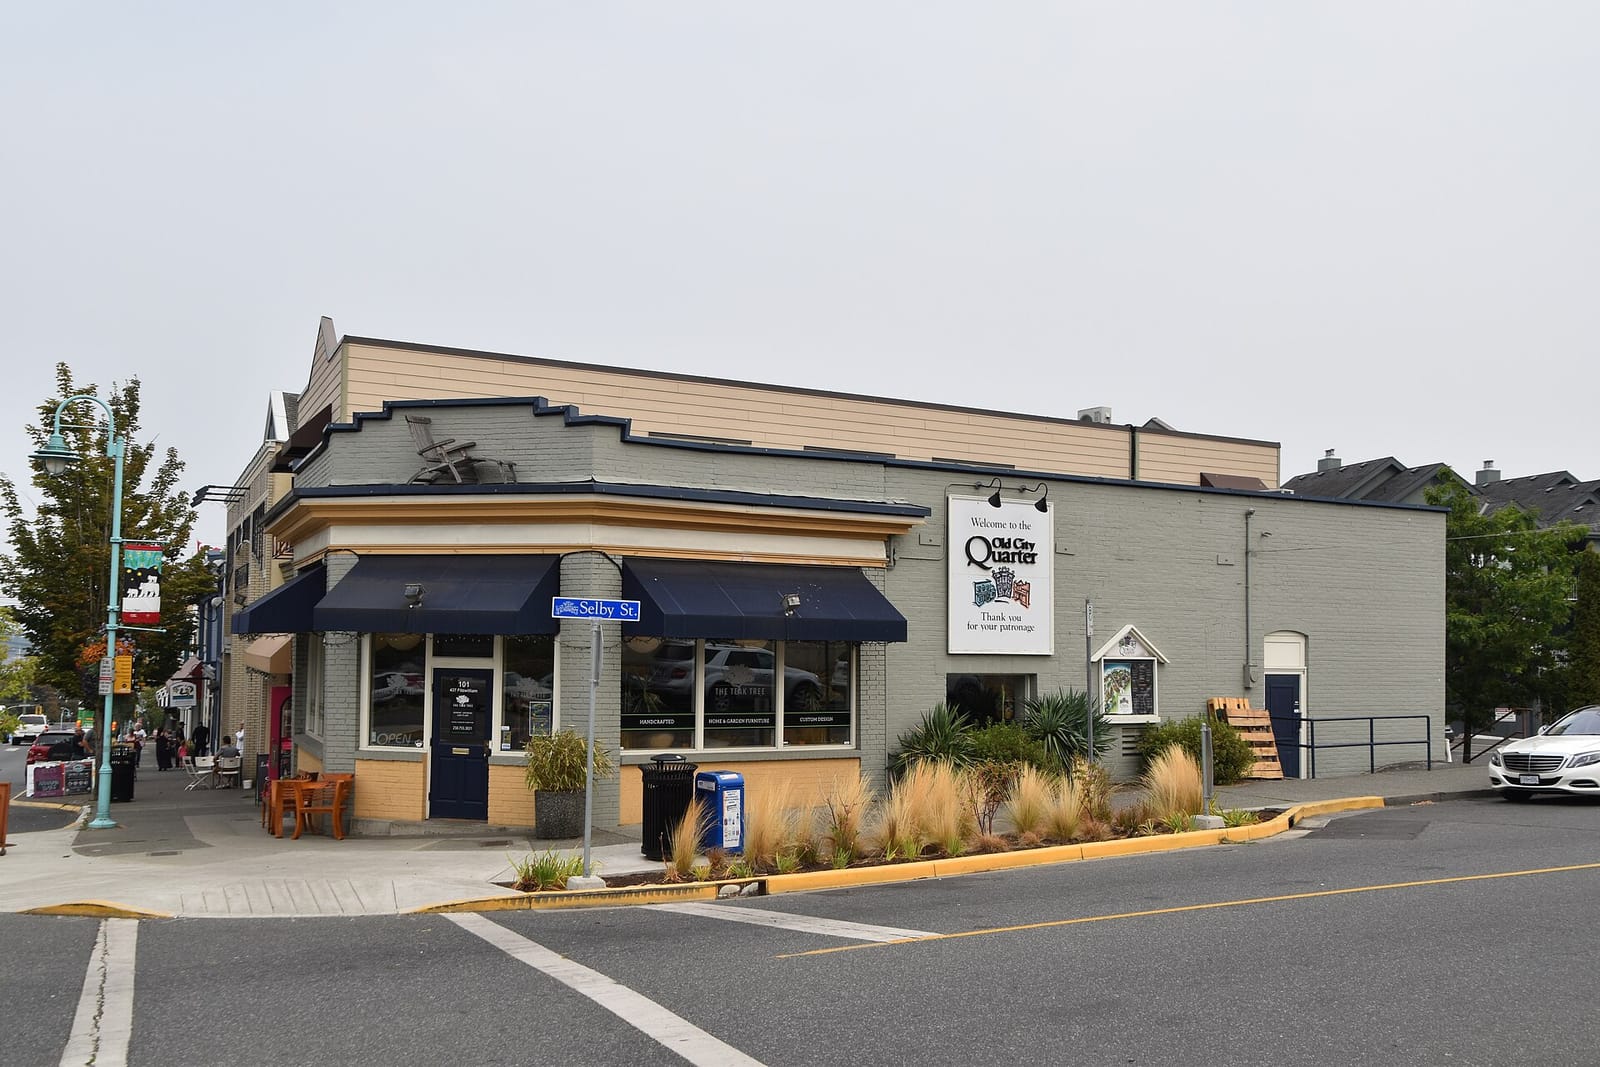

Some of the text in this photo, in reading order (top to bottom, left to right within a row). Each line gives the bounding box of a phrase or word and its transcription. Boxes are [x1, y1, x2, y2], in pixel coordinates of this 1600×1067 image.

[971, 517, 1032, 530] Welcome to the
[992, 537, 1036, 552] Old City
[965, 536, 1038, 570] Quarter
[580, 601, 637, 618] Selby St.
[981, 612, 1006, 621] Thank
[968, 622, 978, 630] for
[1000, 624, 1035, 632] patronage
[715, 688, 727, 696] THE
[749, 688, 765, 696] TREE
[376, 733, 412, 745] OPEN
